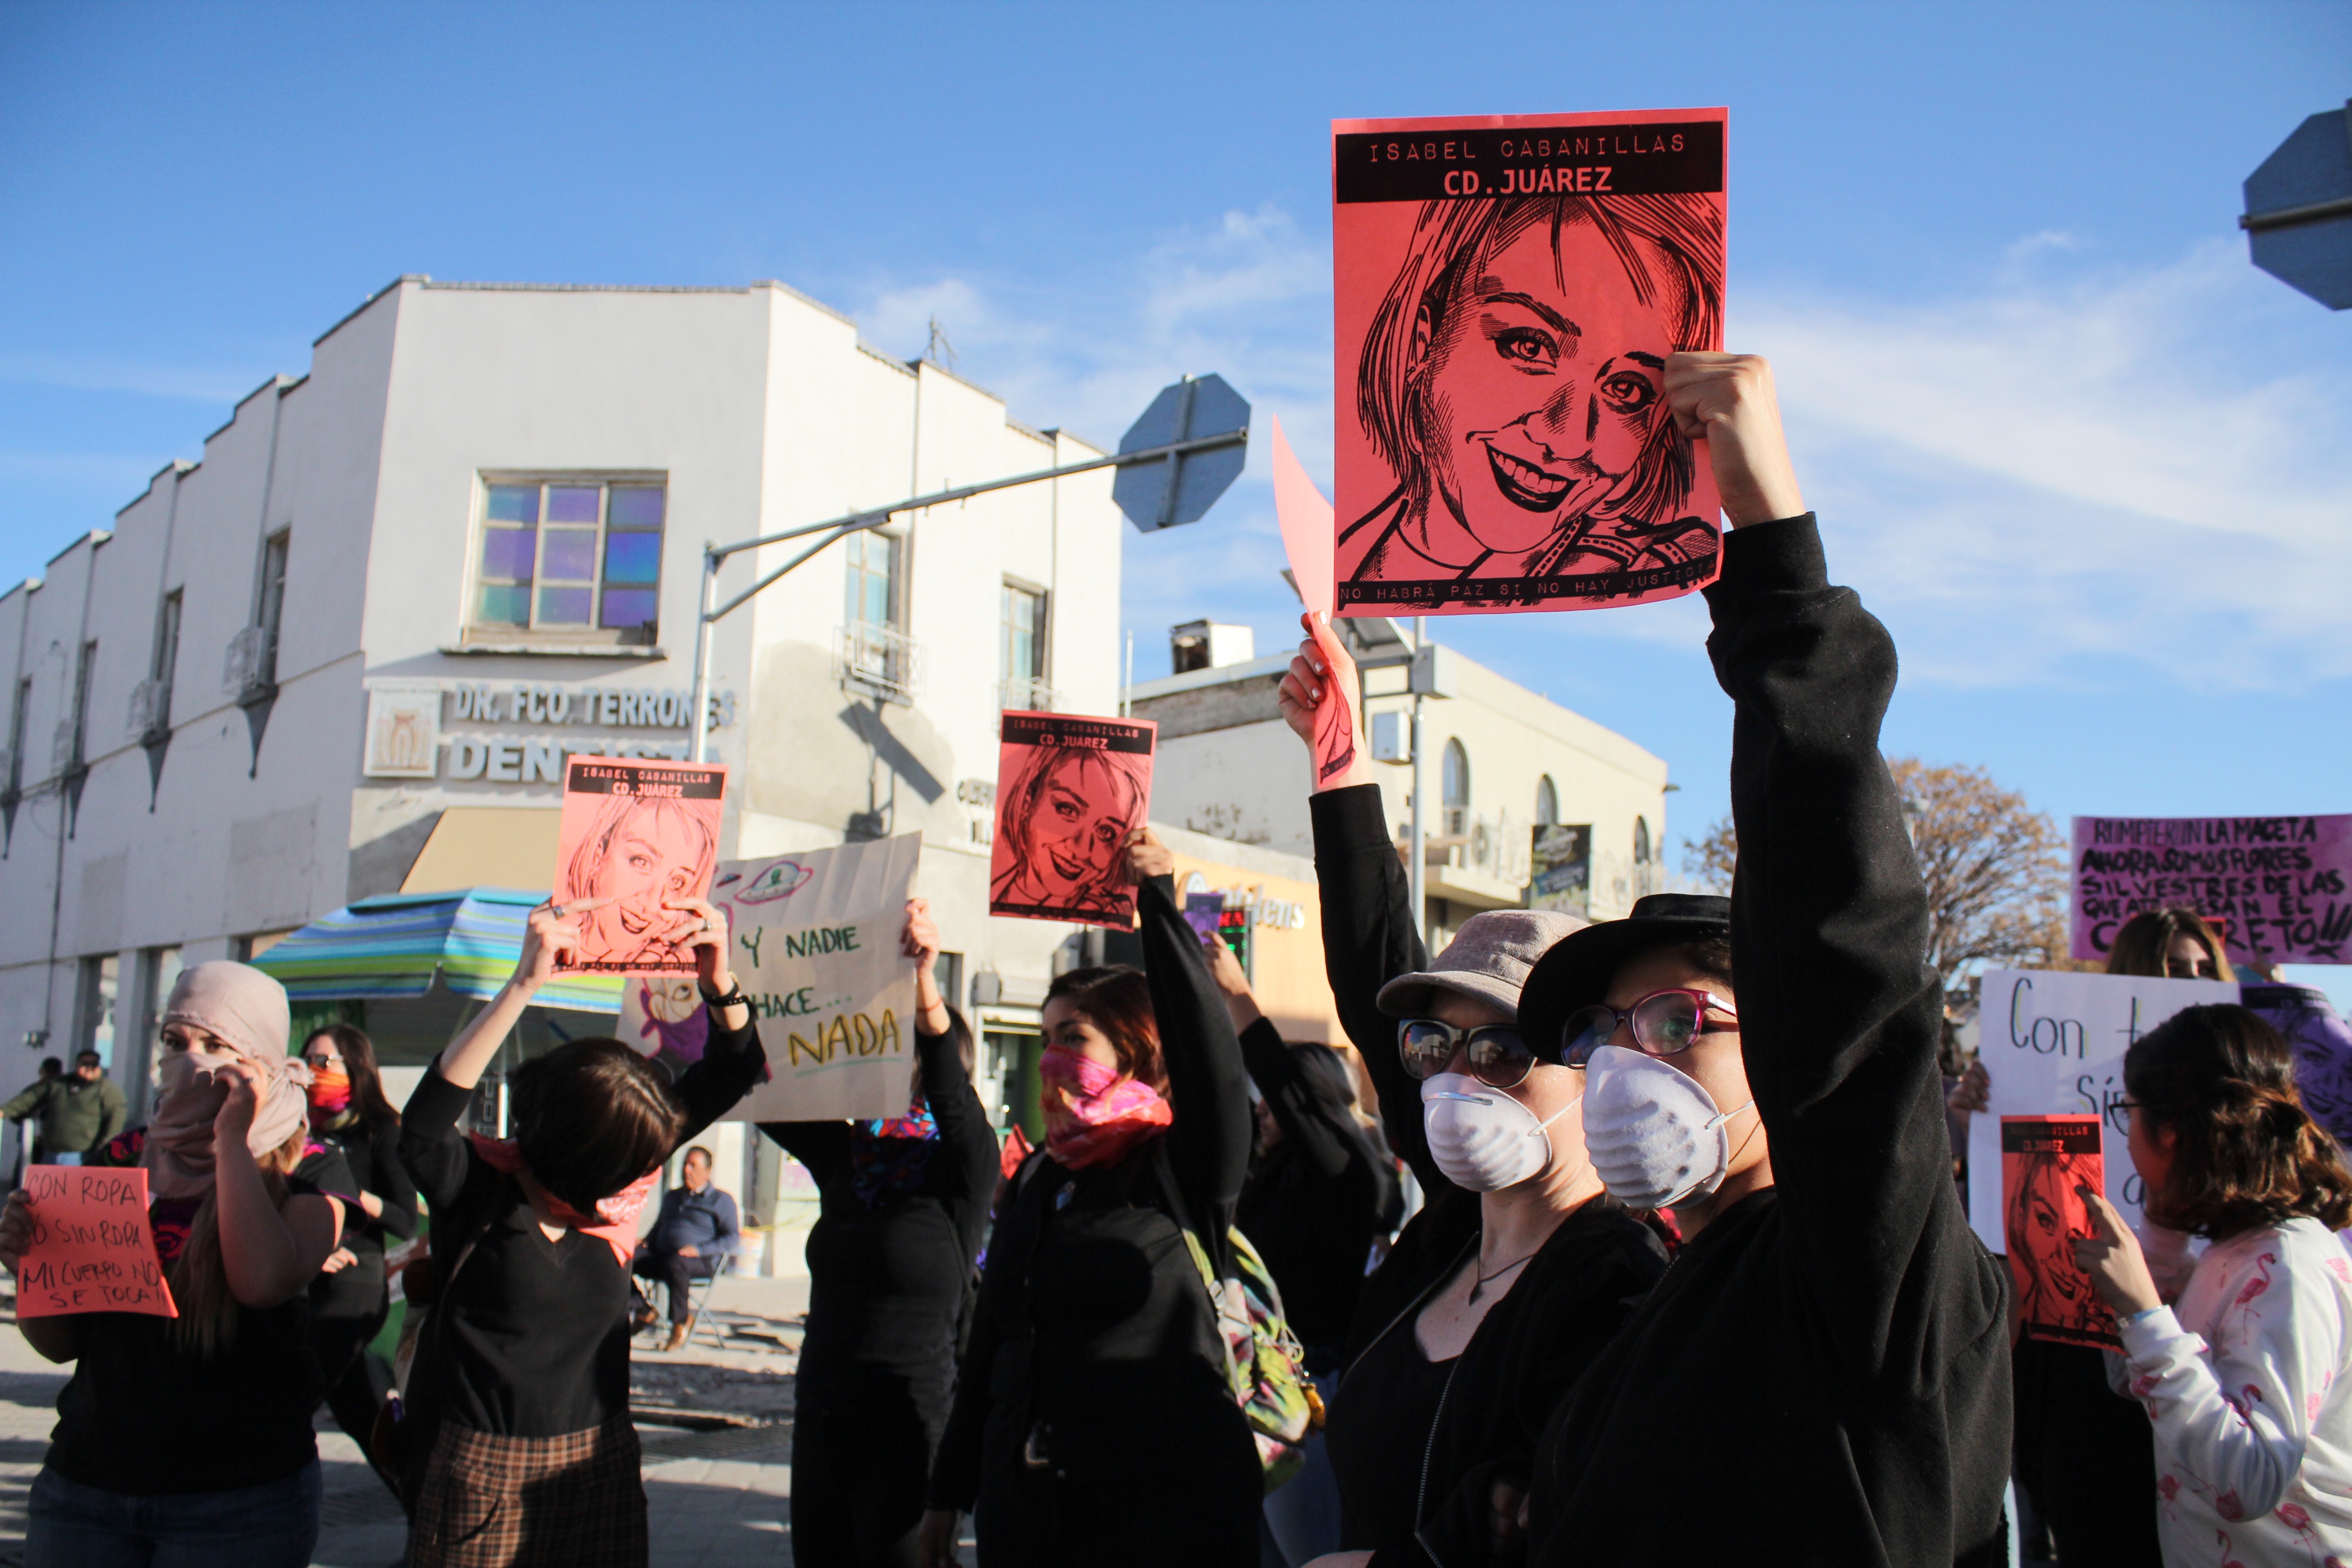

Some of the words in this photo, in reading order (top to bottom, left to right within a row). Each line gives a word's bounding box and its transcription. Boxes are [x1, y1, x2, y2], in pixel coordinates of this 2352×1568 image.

[1370, 142, 1476, 162] ISABEL
[1501, 134, 1686, 157] CABANILLAS
[1341, 588, 1361, 600] NO
[1377, 582, 1436, 599] HABRÁ
[1451, 585, 1484, 597] PAZ
[1500, 584, 1521, 596] SI
[1538, 583, 1559, 594] NO
[1576, 579, 1611, 592] HAY
[1627, 561, 1715, 589] JUSTICIA
[583, 768, 629, 780] ISABEL
[638, 771, 711, 784] CABANILLAS
[2206, 820, 2230, 844] LA
[2081, 876, 2257, 898] SILVESTRES
[2263, 875, 2291, 895] DE
[2299, 869, 2346, 896] LAS
[2082, 897, 2121, 920] QUE
[2278, 896, 2313, 916] EL
[740, 926, 764, 968] Y
[785, 926, 862, 959] NADIE
[2010, 977, 2085, 1059] Con
[788, 1008, 902, 1067] NADA
[27, 1172, 68, 1206] CON
[82, 1176, 137, 1205] ROPA
[55, 1219, 96, 1245] SIN
[99, 1220, 143, 1250] ROPA
[24, 1262, 55, 1293] MI
[62, 1260, 122, 1286] CUERPO
[133, 1259, 160, 1287] NO
[49, 1290, 88, 1308] SE
